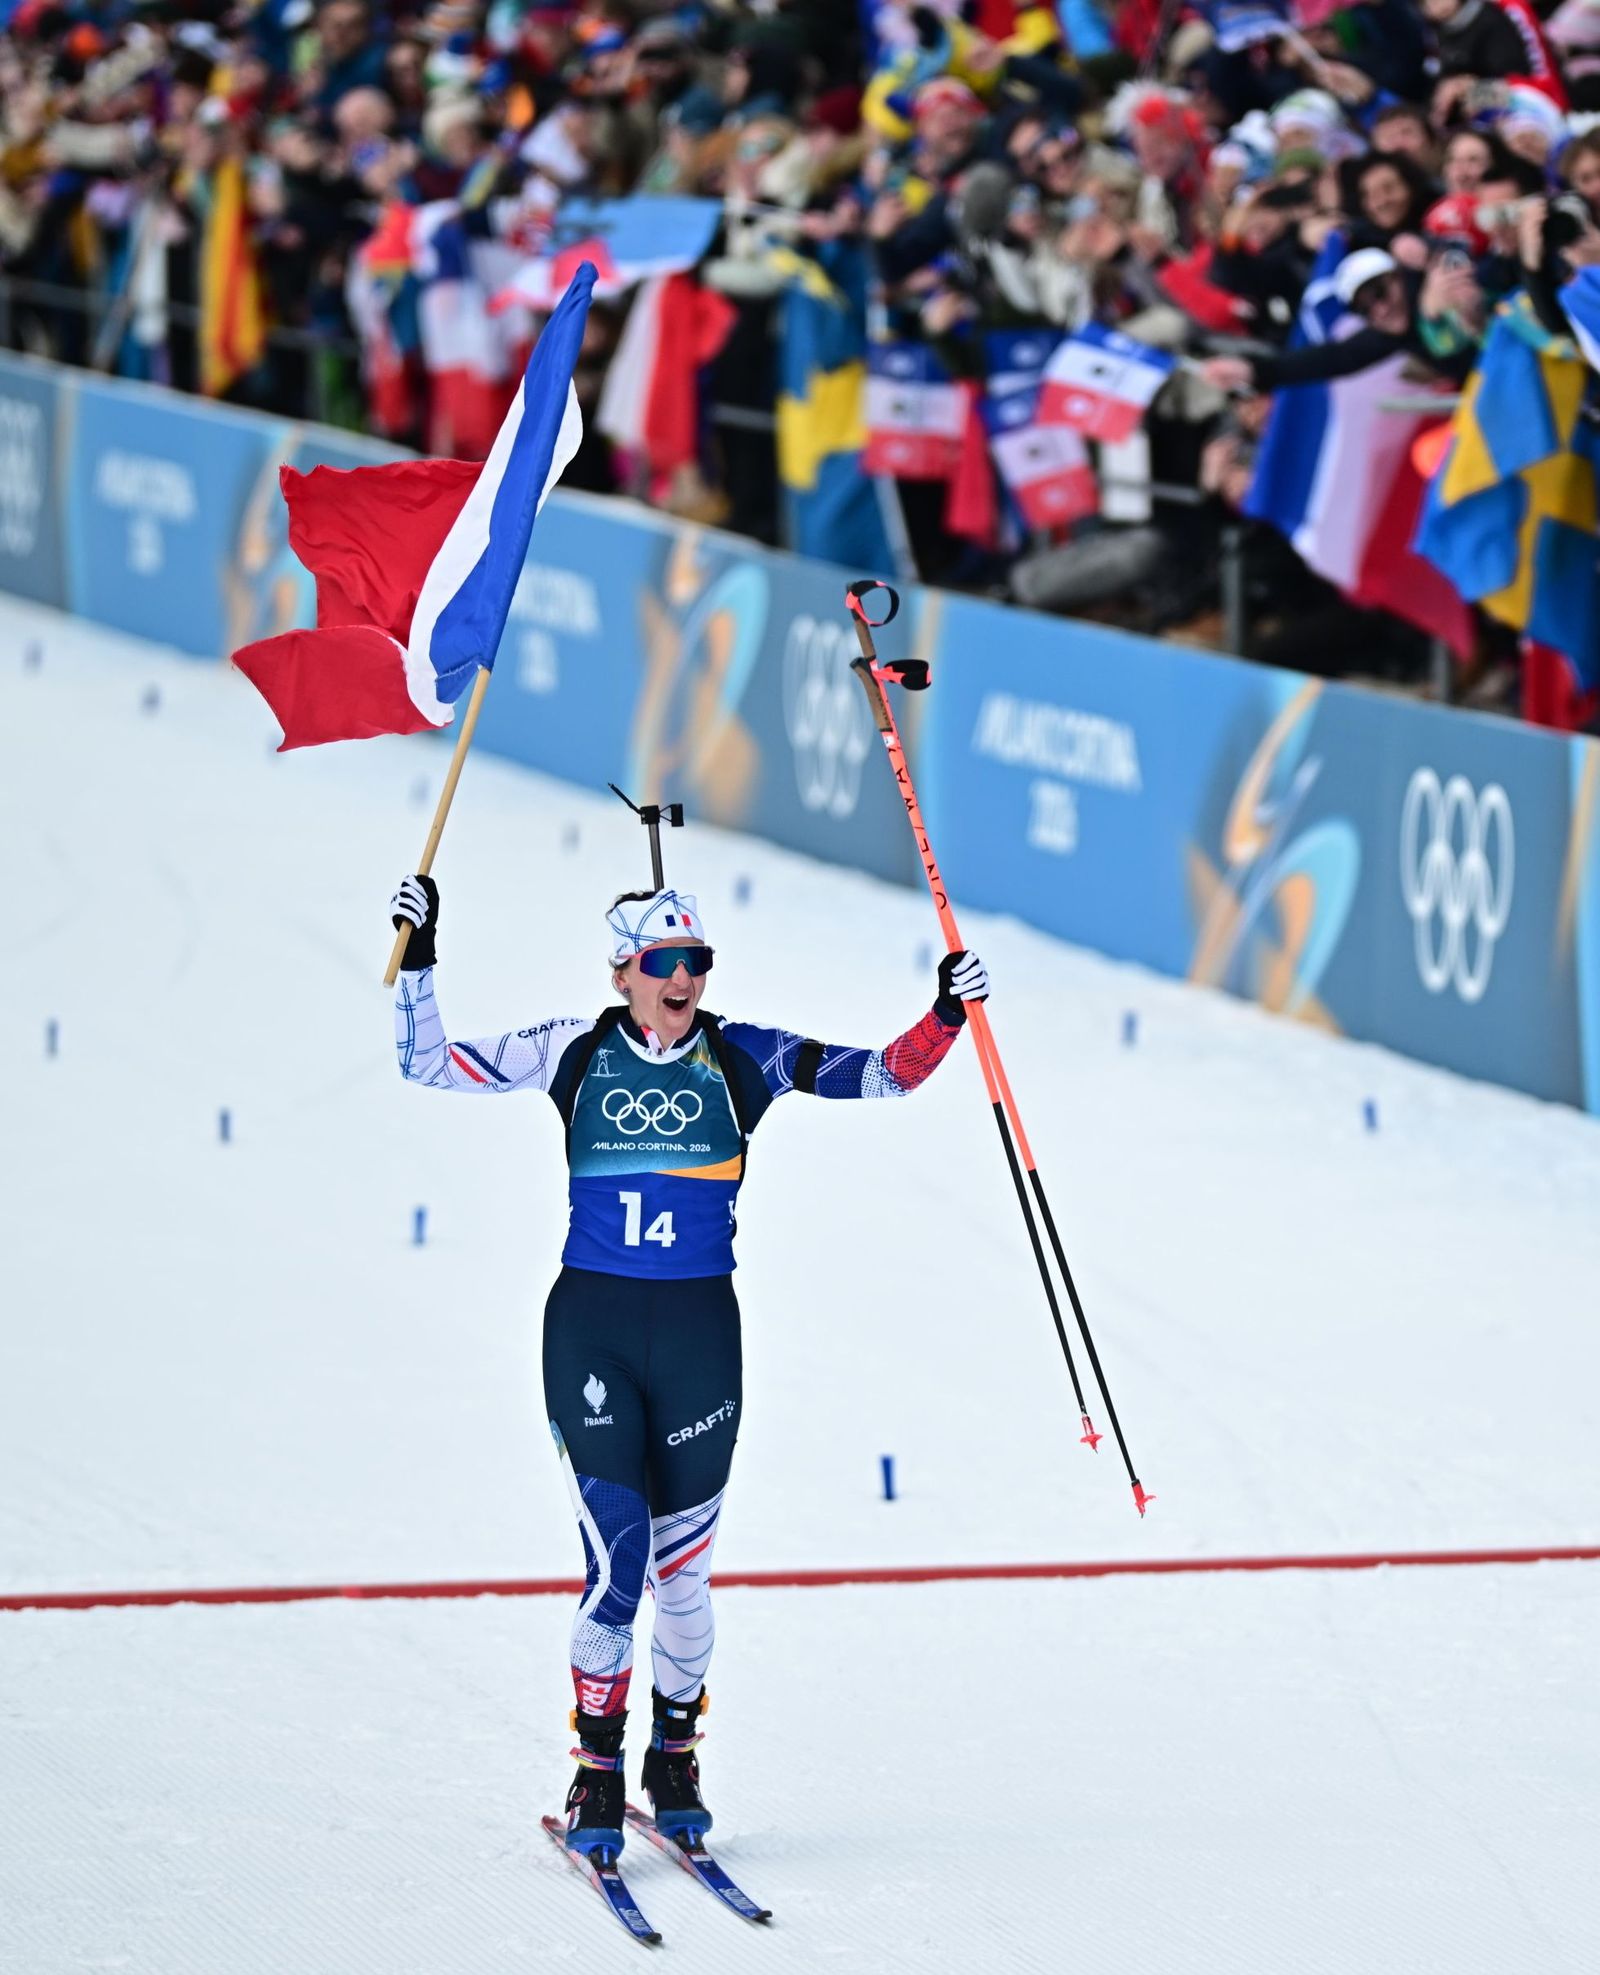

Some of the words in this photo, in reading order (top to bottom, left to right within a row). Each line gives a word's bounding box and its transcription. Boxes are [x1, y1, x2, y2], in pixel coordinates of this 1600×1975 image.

[517, 1018, 568, 1038] CRAFT
[591, 1142, 636, 1151] MILANO
[637, 1142, 687, 1152] CORTINA
[689, 1144, 711, 1153] 2026
[584, 1414, 614, 1427] FRANCE
[667, 1407, 725, 1446] CRAFT
[581, 1678, 614, 1717] FRA
